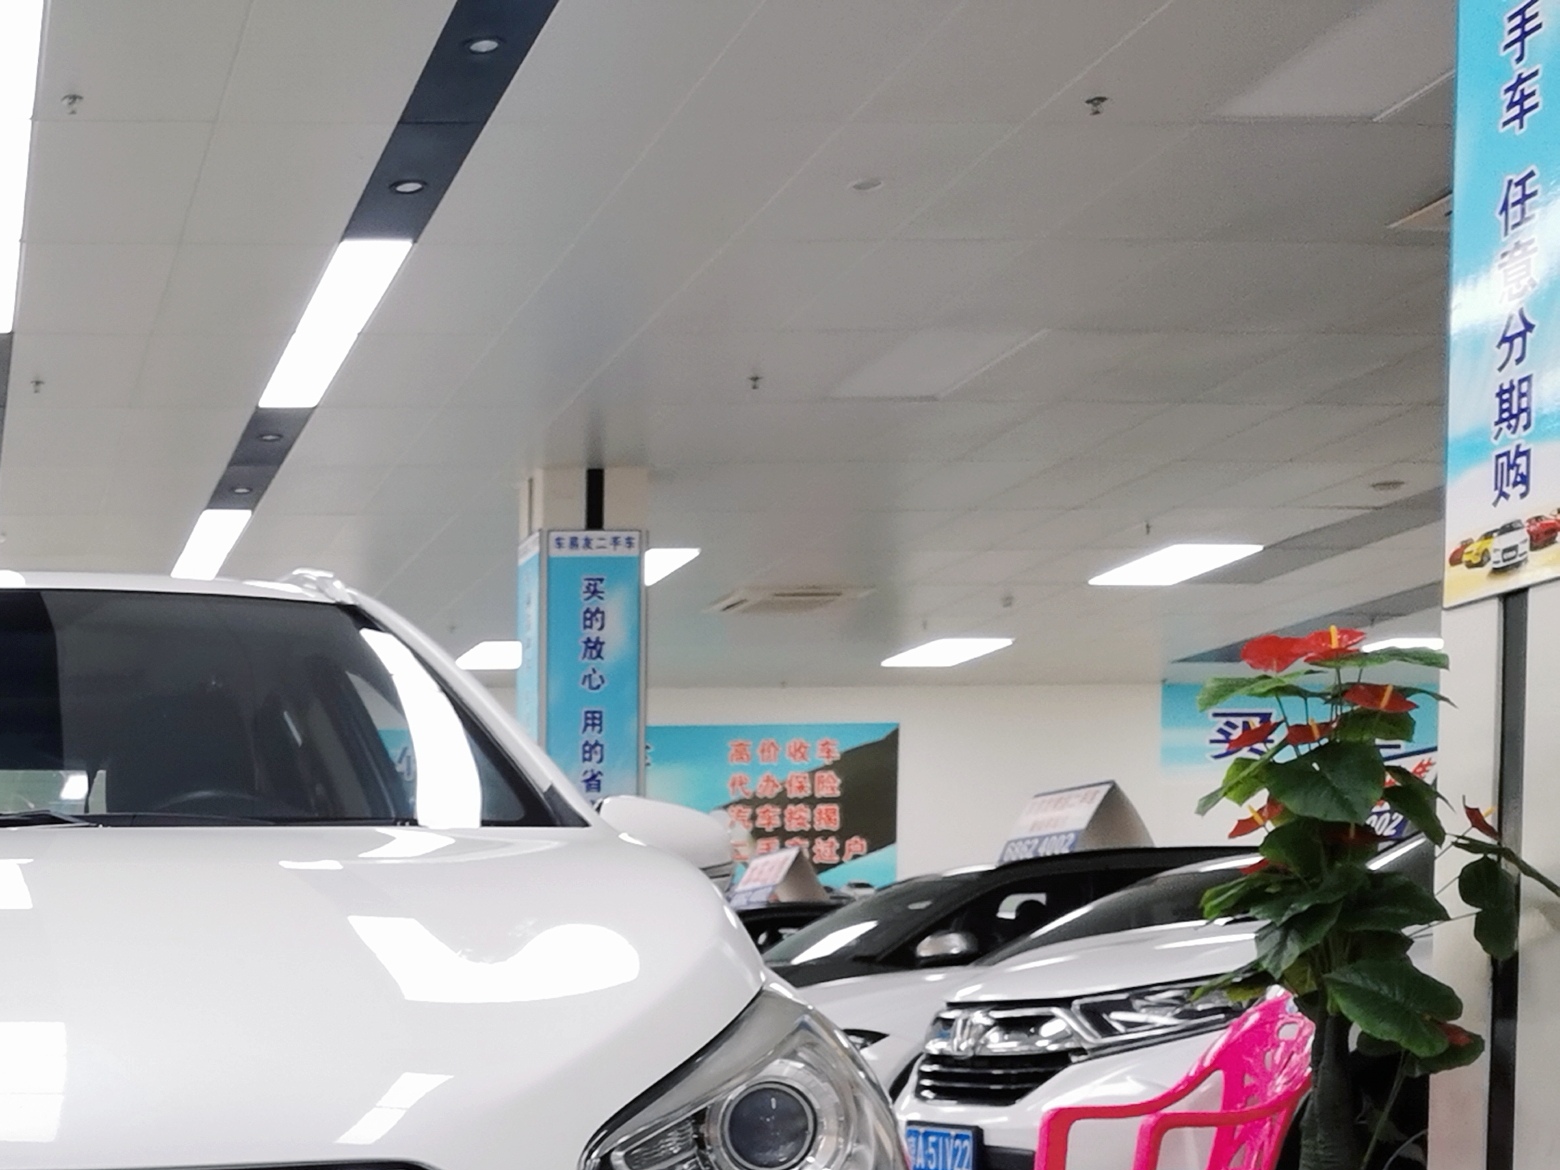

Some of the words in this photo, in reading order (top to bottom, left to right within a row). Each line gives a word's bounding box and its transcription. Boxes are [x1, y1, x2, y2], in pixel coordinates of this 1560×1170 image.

[1492, 169, 1539, 508] 任意分期购
[580, 577, 606, 691] 买的放心
[580, 710, 605, 804] 用的省
[728, 739, 840, 764] 高价收车
[728, 771, 841, 798] 代办保险
[727, 803, 840, 831] 汽车按揭
